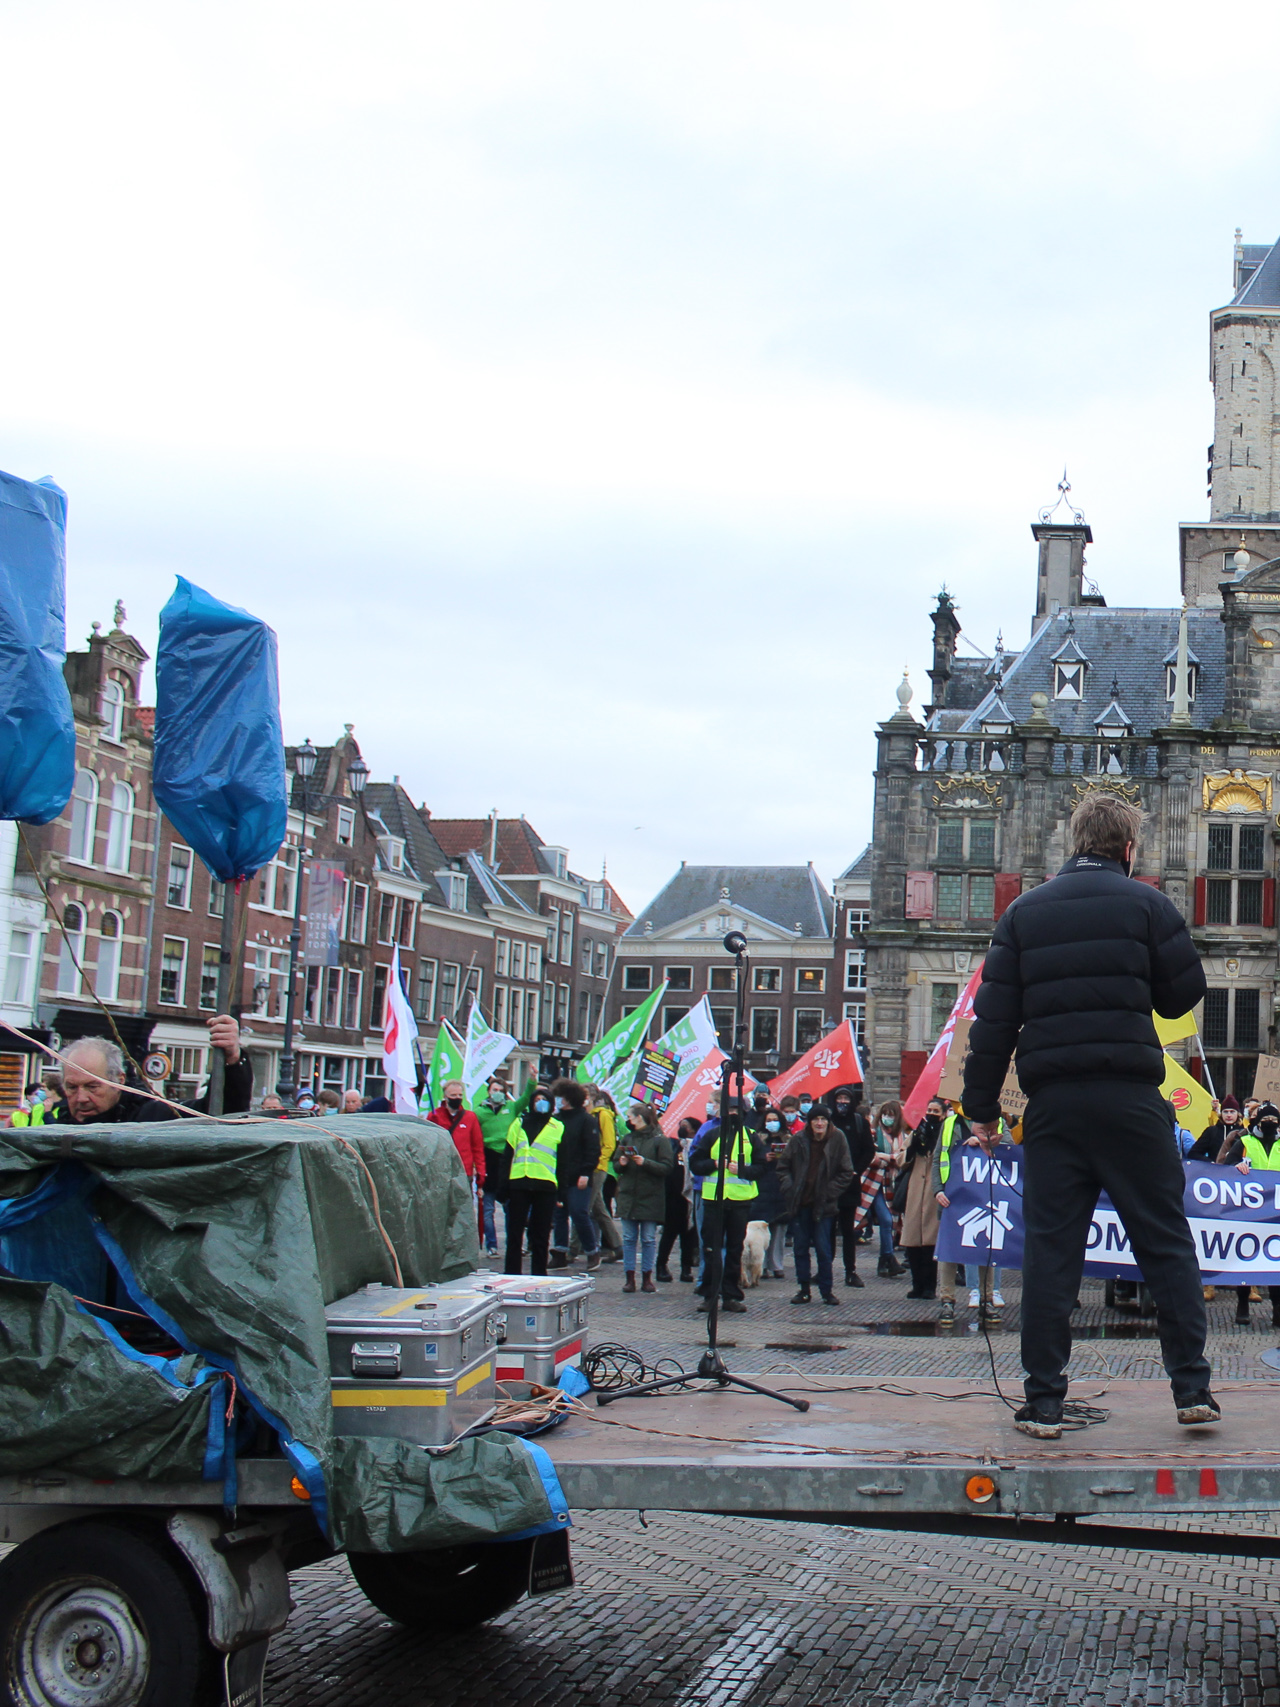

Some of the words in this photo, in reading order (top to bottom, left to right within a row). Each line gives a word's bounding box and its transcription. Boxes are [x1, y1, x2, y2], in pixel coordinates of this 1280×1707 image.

[1201, 746, 1217, 755] DEL
[961, 1155, 1019, 1187] WIJ
[1192, 1176, 1265, 1211] ONS
